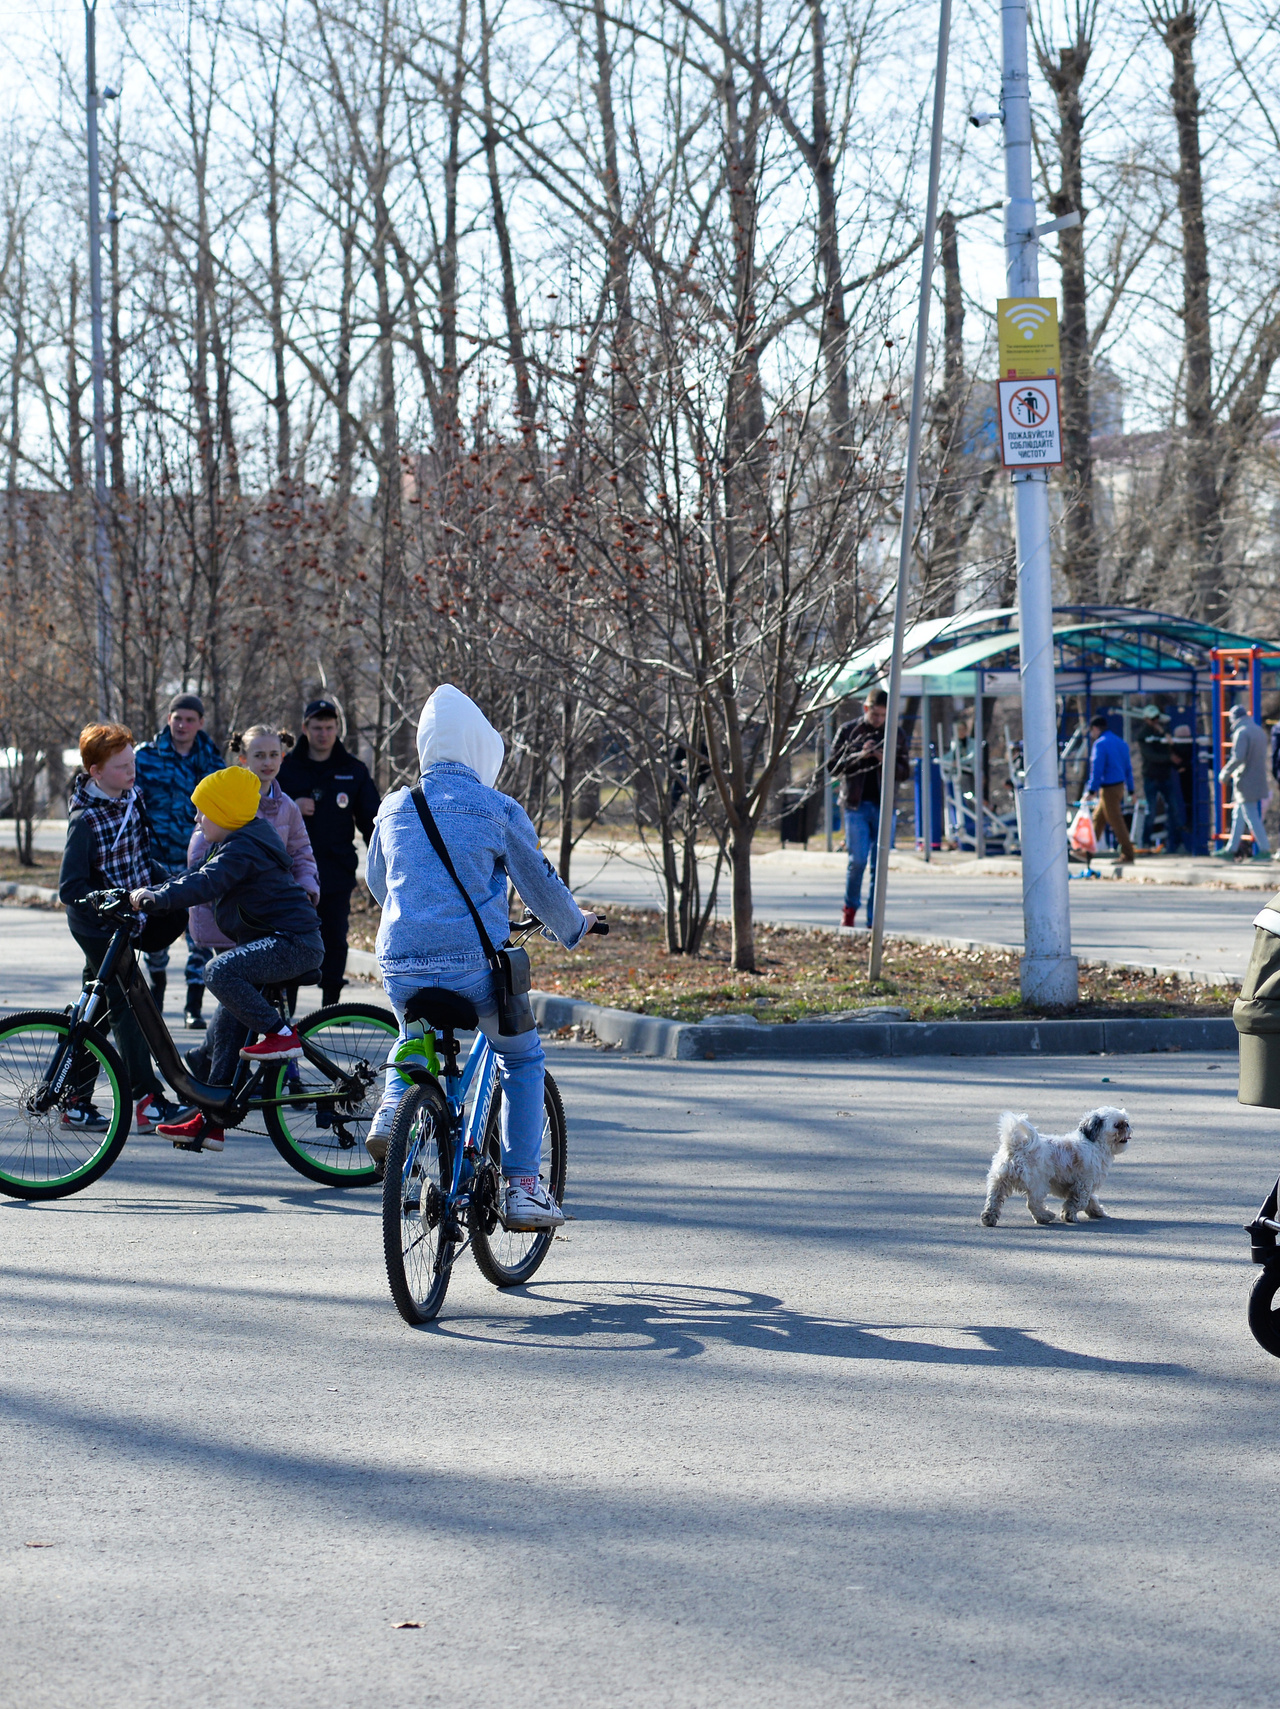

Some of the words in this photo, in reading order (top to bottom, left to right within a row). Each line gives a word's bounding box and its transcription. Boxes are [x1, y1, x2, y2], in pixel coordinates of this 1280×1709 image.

[1008, 429, 1055, 440] ПОЖАЛУЙСТА!
[1010, 438, 1054, 450] СОБЛЮДАЙТЕ
[1018, 449, 1047, 459] ЧИСТОТУ
[54, 1057, 73, 1094] COMIRON
[476, 1052, 498, 1152] FORWA
